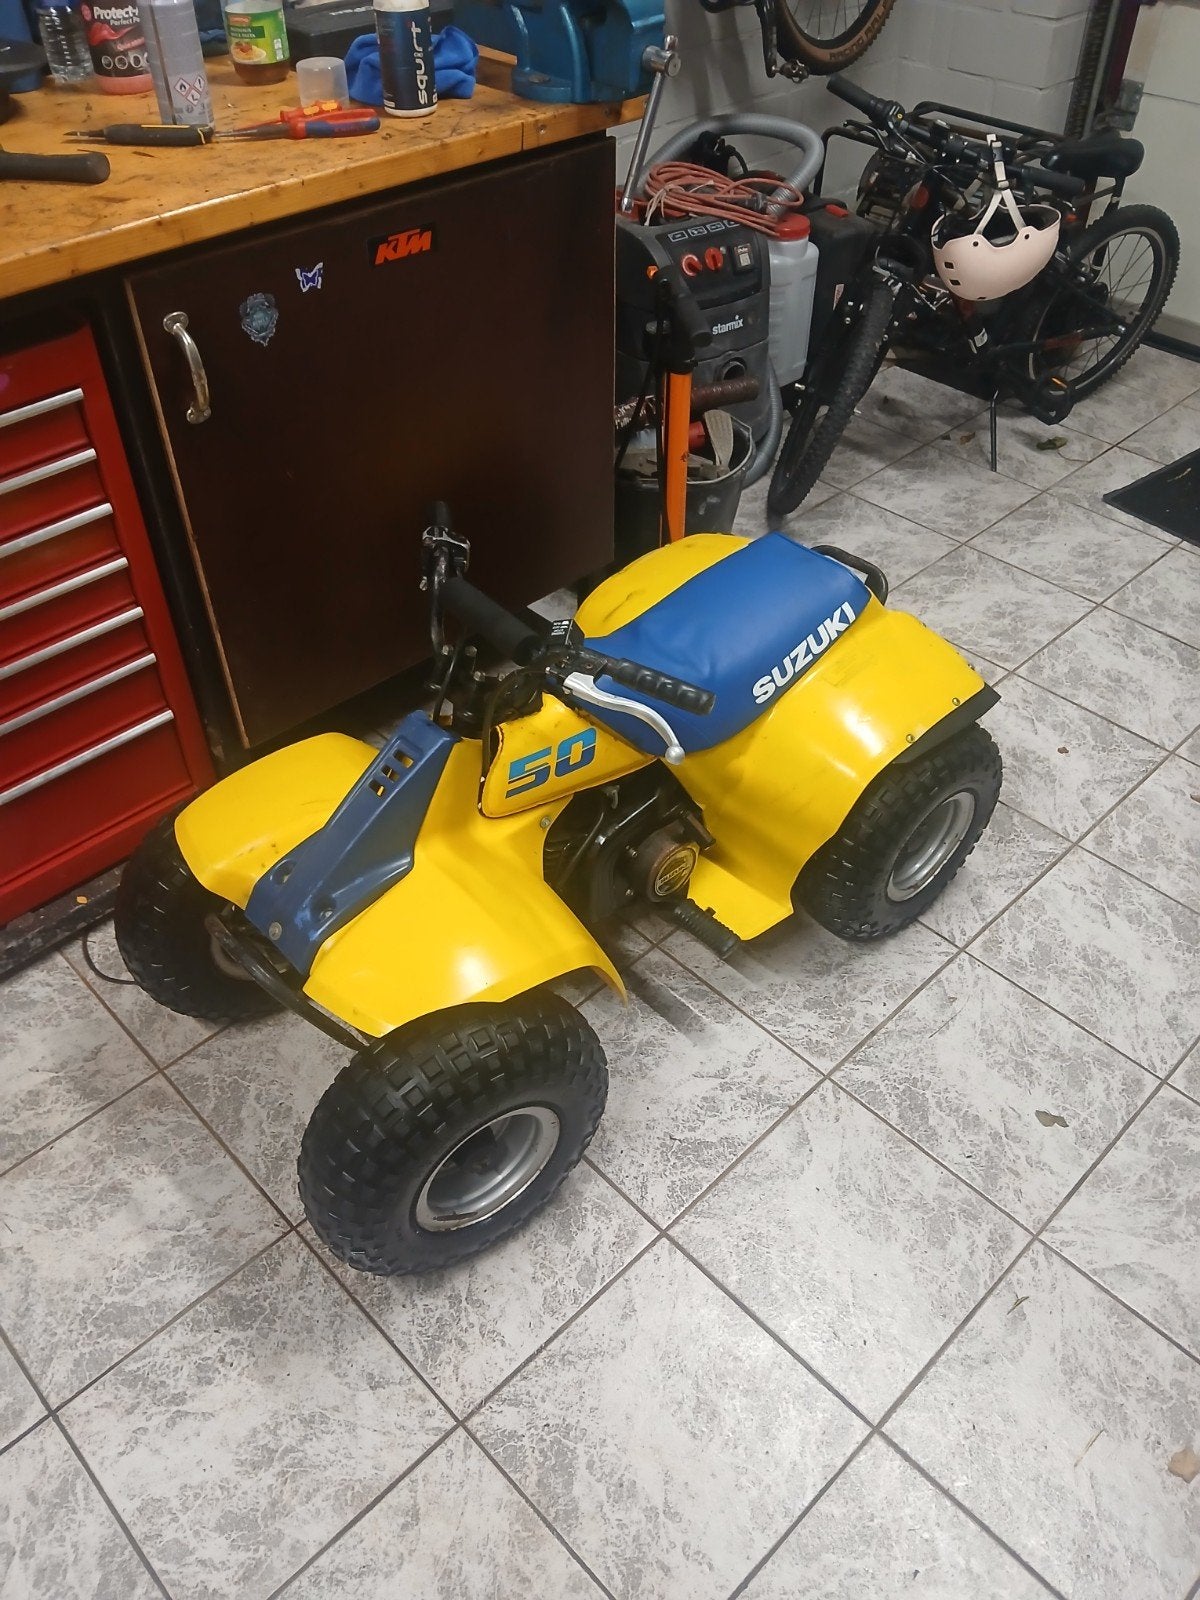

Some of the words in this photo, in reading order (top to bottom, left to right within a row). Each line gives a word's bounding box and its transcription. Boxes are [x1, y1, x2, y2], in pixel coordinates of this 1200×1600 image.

[411, 21, 428, 104] squirt
[375, 229, 432, 265] KTM
[712, 314, 744, 335] starmix
[752, 601, 856, 704] SUZUKI
[505, 731, 597, 799] 50
